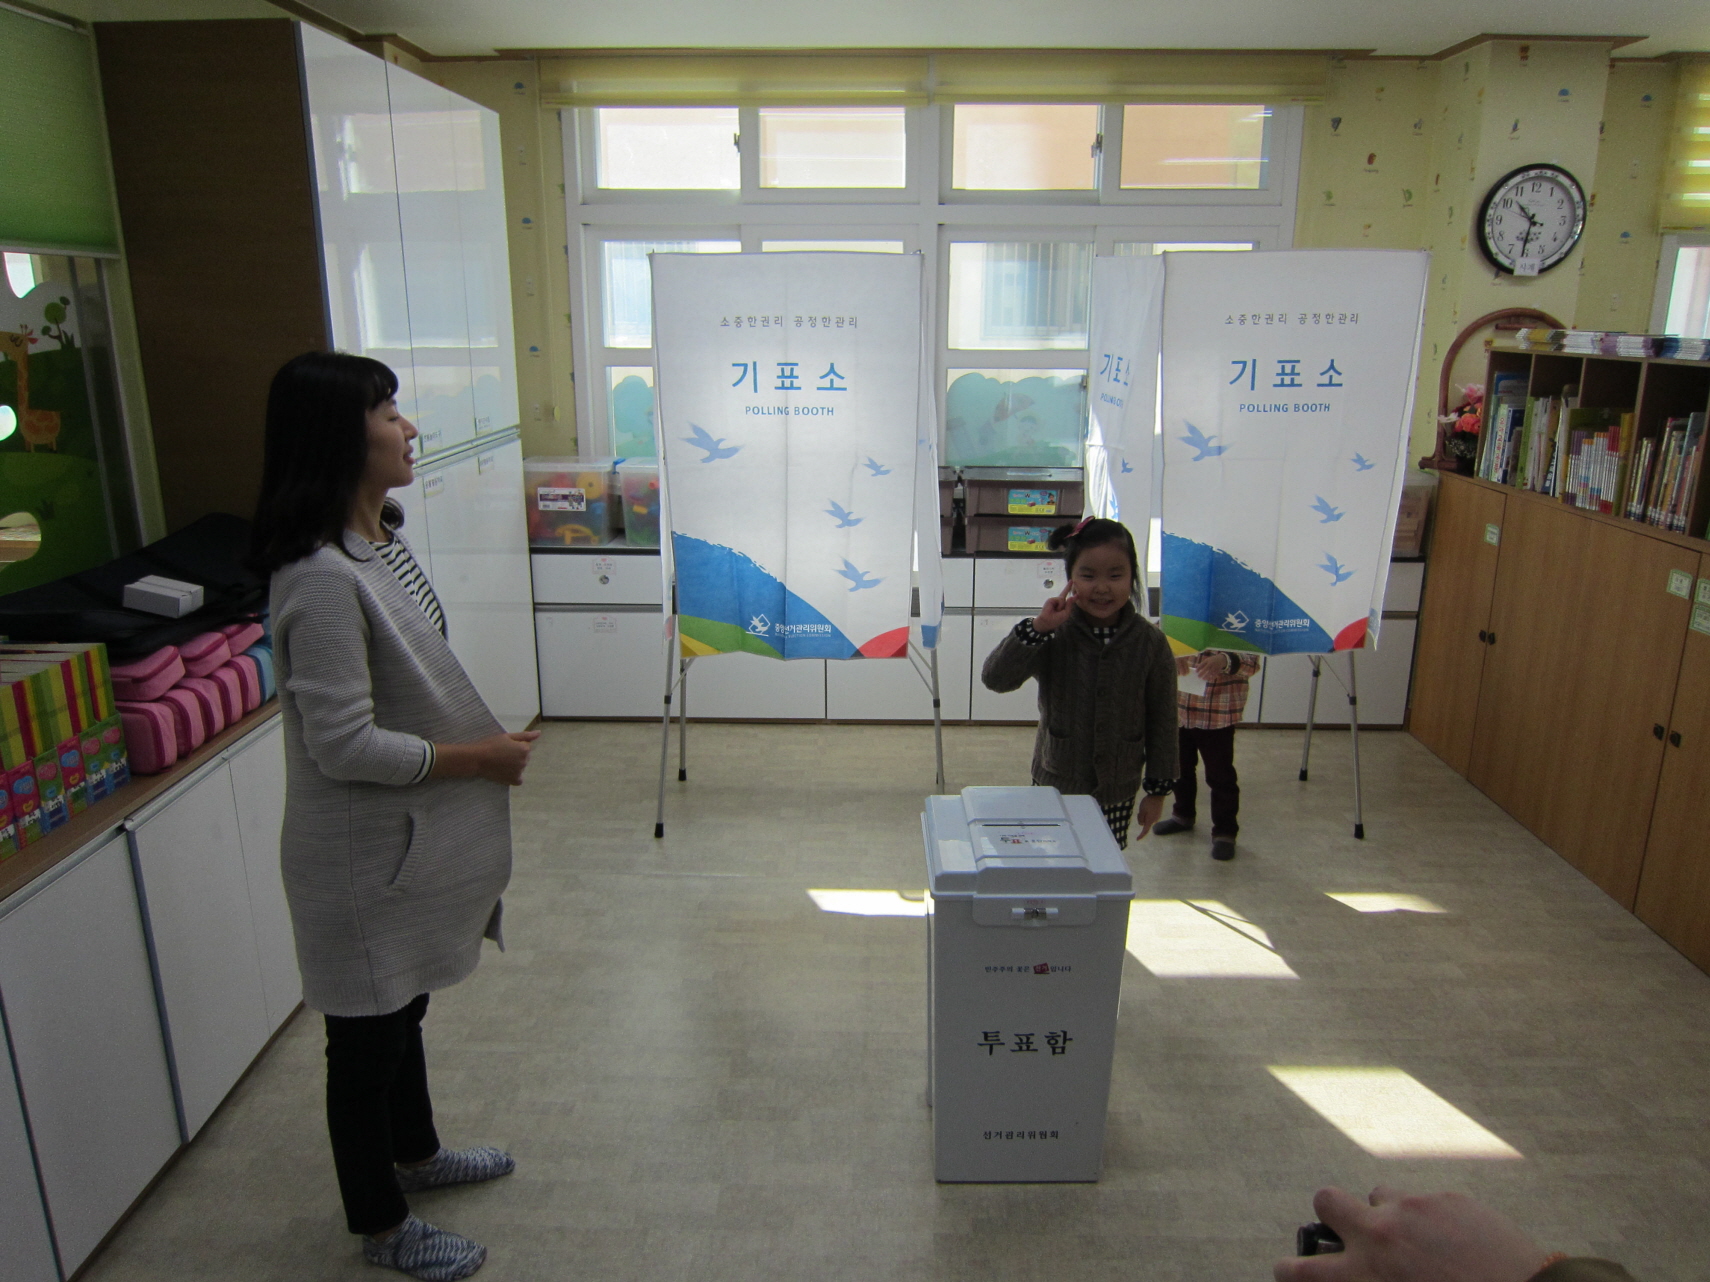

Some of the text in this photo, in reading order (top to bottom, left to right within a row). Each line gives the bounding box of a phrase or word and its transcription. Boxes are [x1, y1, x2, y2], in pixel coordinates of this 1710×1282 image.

[1515, 186, 1524, 197] 11
[1531, 182, 1542, 193] 12
[1549, 187, 1555, 197] 1
[1502, 198, 1513, 209] 10
[1557, 199, 1564, 209] 2
[1495, 216, 1502, 225] 9
[1559, 216, 1566, 226] 3
[1498, 231, 1504, 241] 8
[1552, 232, 1557, 242] 4
[1508, 244, 1514, 254] 7
[1538, 245, 1545, 254] 5
[720, 315, 859, 329] 소중한권리 공정한관리
[1224, 312, 1360, 325] 소중한권리 공정한관리
[731, 360, 848, 394] 기표소
[1228, 357, 1344, 391] 기표소
[744, 406, 835, 416] POLLING BOOTH
[1238, 402, 1331, 413] POLLING BOOTH
[775, 623, 832, 634] 중앙선거관리위원회
[984, 965, 1014, 973] 민주주의
[1016, 965, 1031, 973] 꽃은
[976, 1030, 1074, 1056] 투표함
[983, 1130, 1060, 1140] 선거관리위원회
